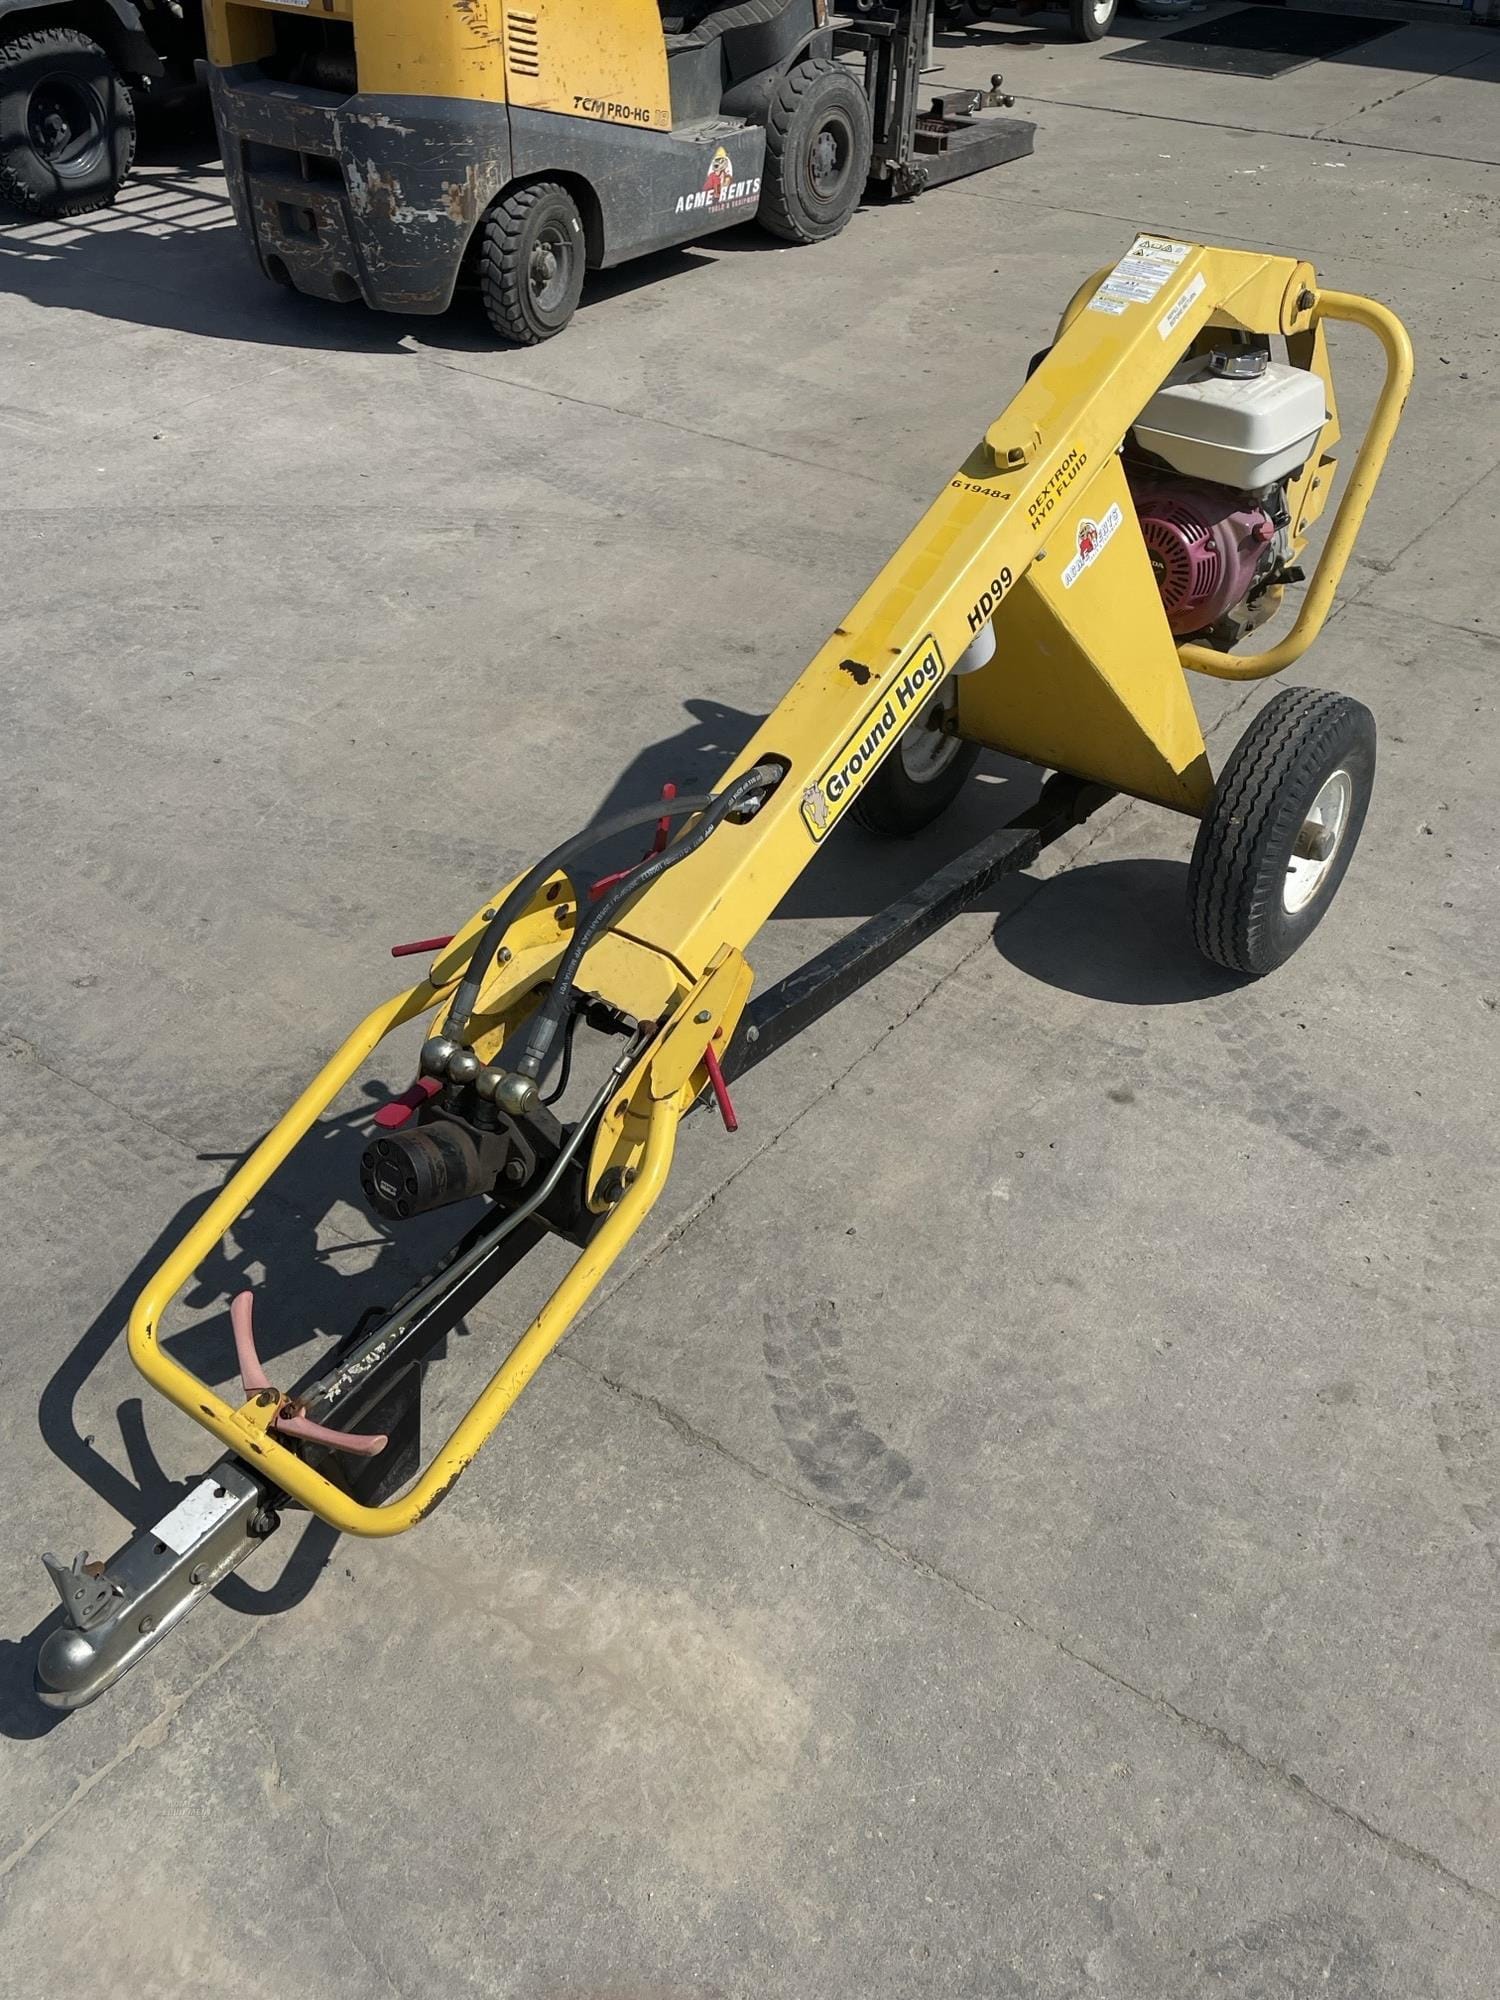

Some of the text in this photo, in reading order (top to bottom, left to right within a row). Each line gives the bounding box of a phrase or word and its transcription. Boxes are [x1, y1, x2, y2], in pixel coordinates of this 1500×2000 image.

[573, 96, 605, 117] TCM
[607, 102, 650, 122] PRO-HG
[675, 177, 762, 215] ACME RENTS
[951, 479, 1012, 501] 619484
[1028, 449, 1078, 517] DEXTRON
[1031, 453, 1088, 531] HYD FLUID
[967, 566, 1013, 633] HD99
[826, 653, 938, 802] Ground Hog
